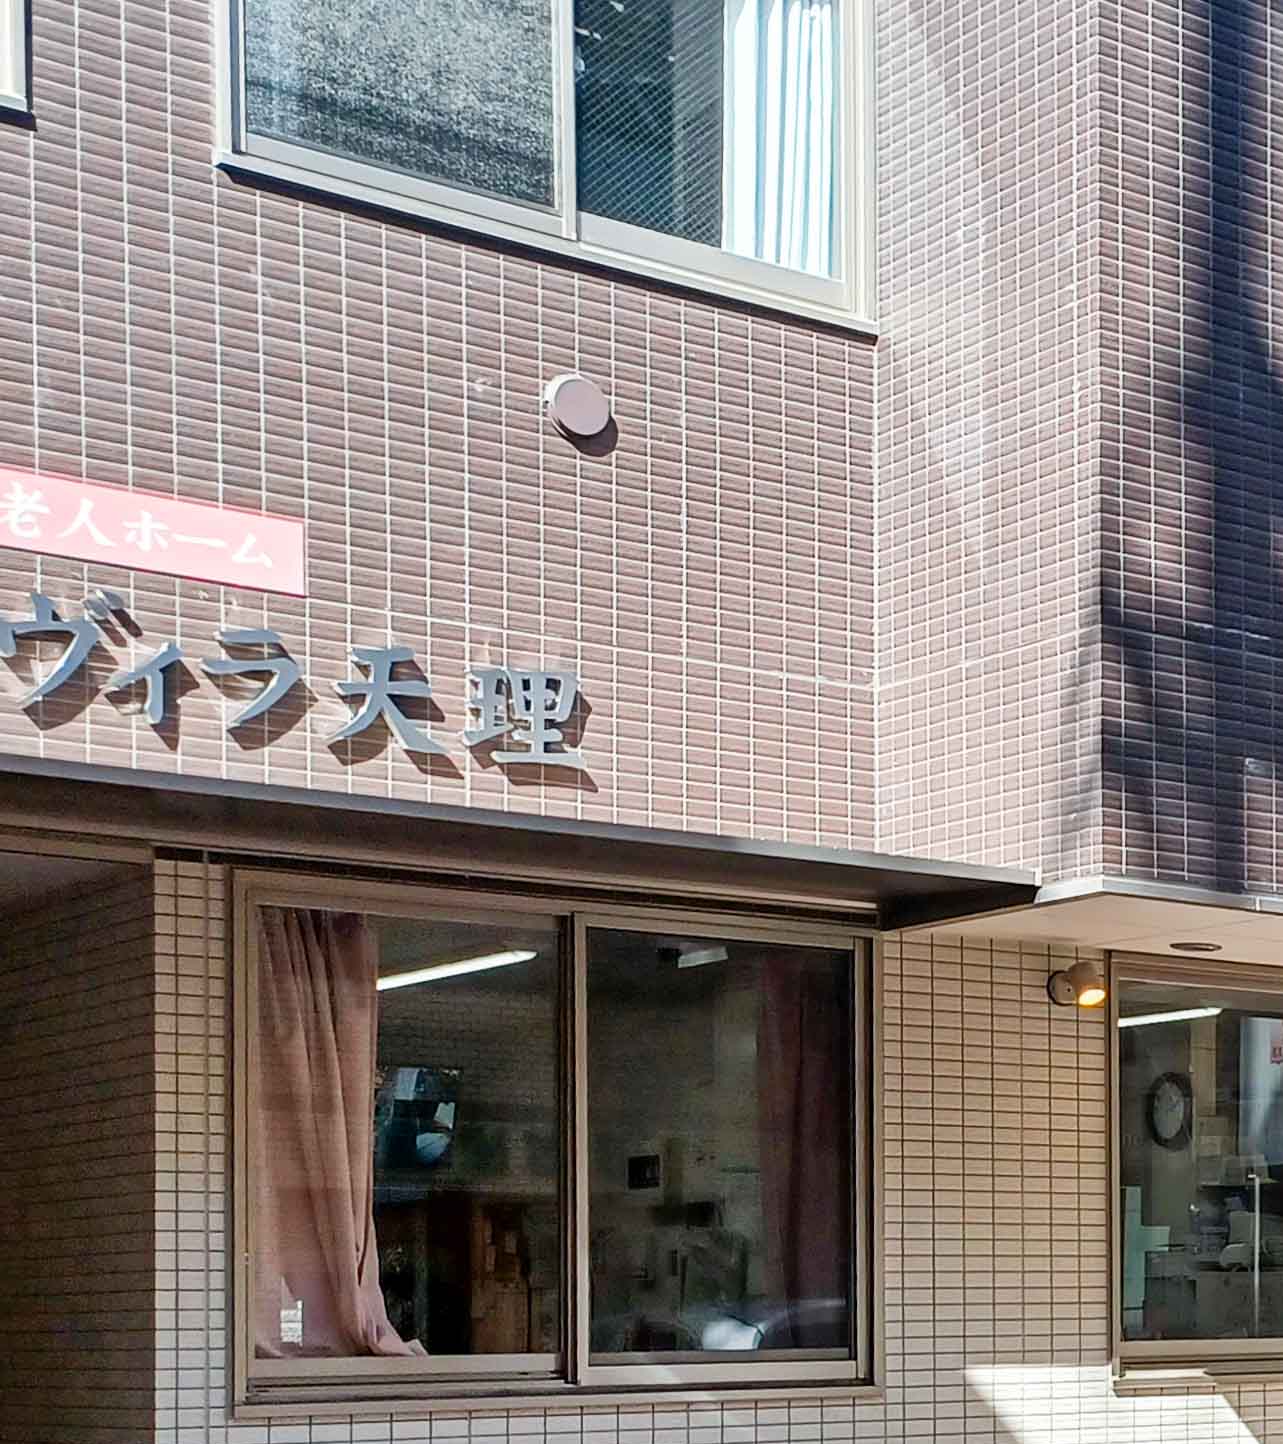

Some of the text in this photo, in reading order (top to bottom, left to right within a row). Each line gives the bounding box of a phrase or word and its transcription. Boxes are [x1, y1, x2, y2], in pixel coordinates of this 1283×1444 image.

[0, 480, 274, 569] 老人ホーム
[0, 590, 587, 763] ヴィラ天理
